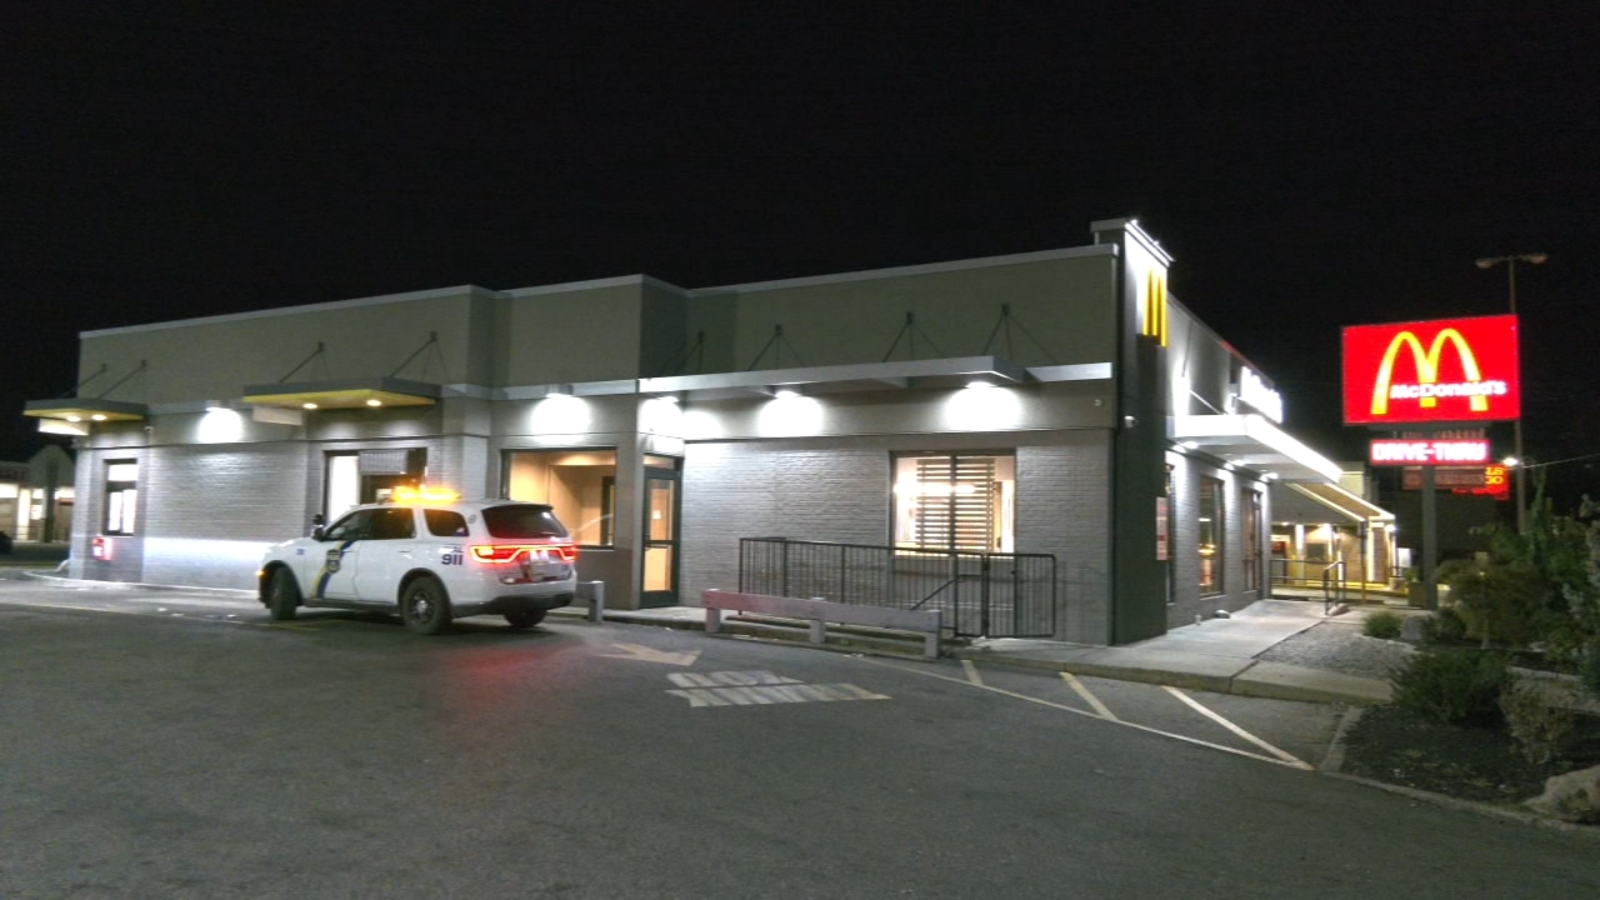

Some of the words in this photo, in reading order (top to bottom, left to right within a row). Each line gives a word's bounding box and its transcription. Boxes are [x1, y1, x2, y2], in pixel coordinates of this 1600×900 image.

[1389, 380, 1508, 399] McDonald's
[1371, 442, 1487, 461] DRIVE-THRU
[441, 554, 464, 566] 911
